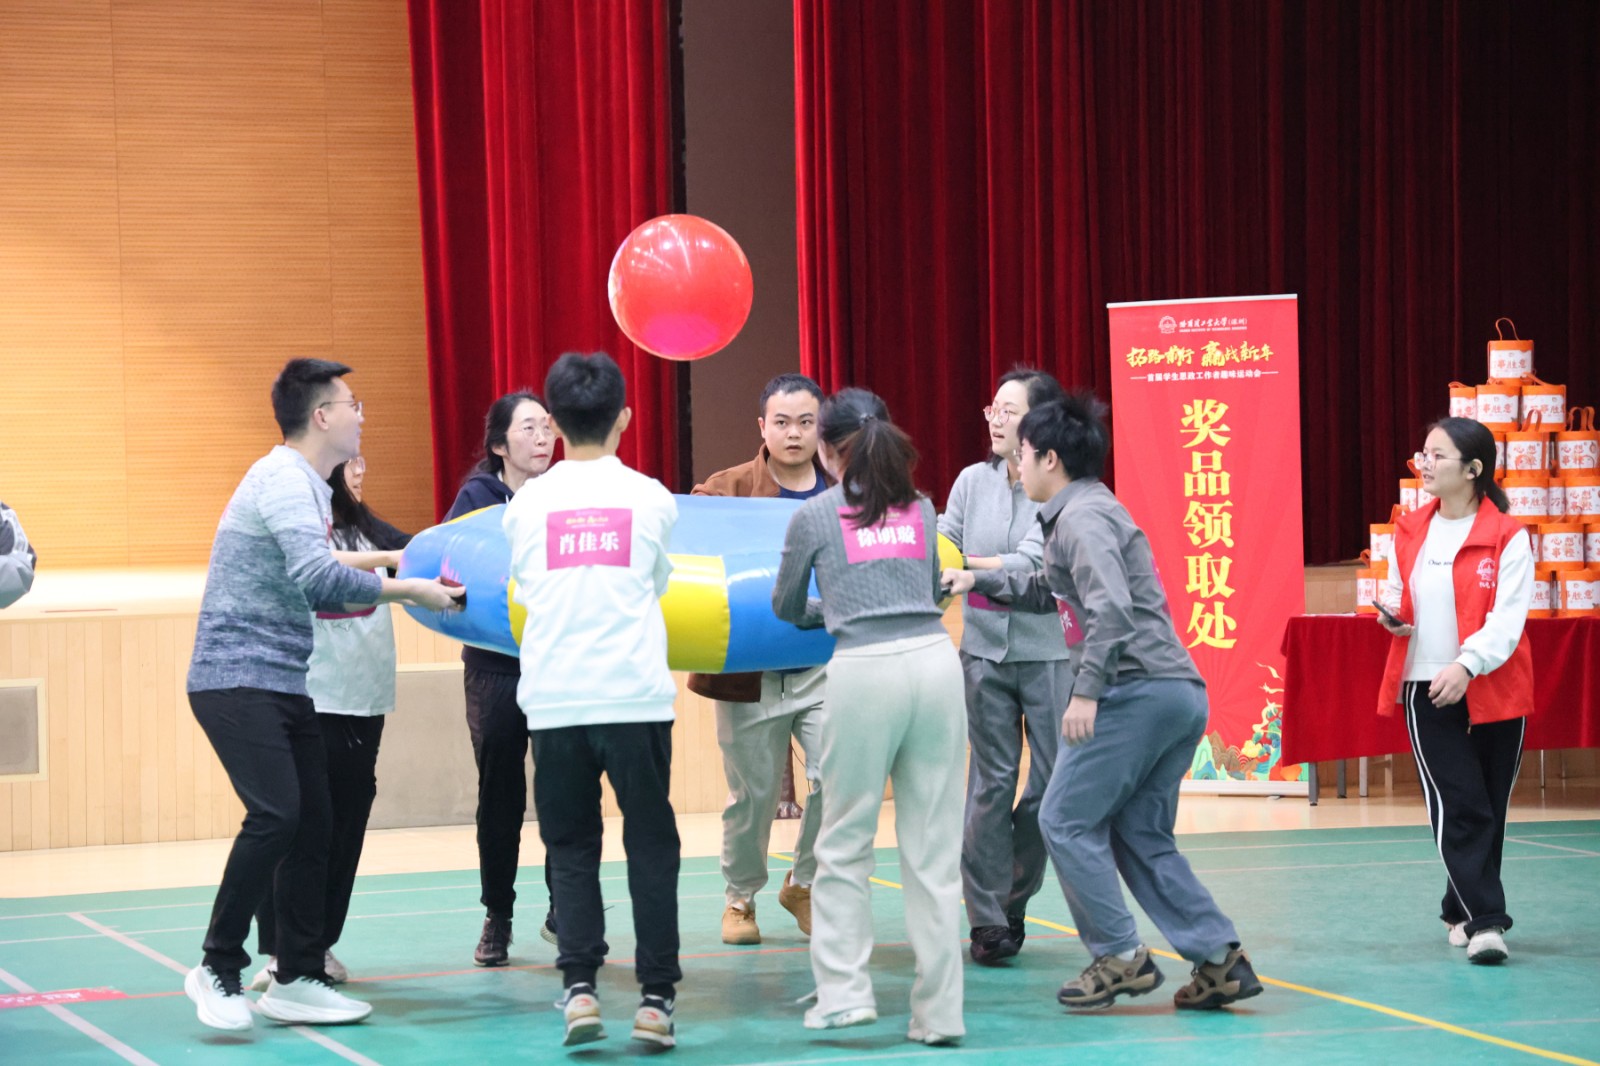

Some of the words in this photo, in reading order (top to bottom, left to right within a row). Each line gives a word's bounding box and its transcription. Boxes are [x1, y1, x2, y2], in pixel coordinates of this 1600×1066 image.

[1201, 340, 1274, 367] 赢战新年
[1147, 369, 1262, 382] 首届学生思政工作者趣味运动会
[1180, 399, 1237, 649] 奖品领取处
[559, 531, 619, 556] 肖佳乐
